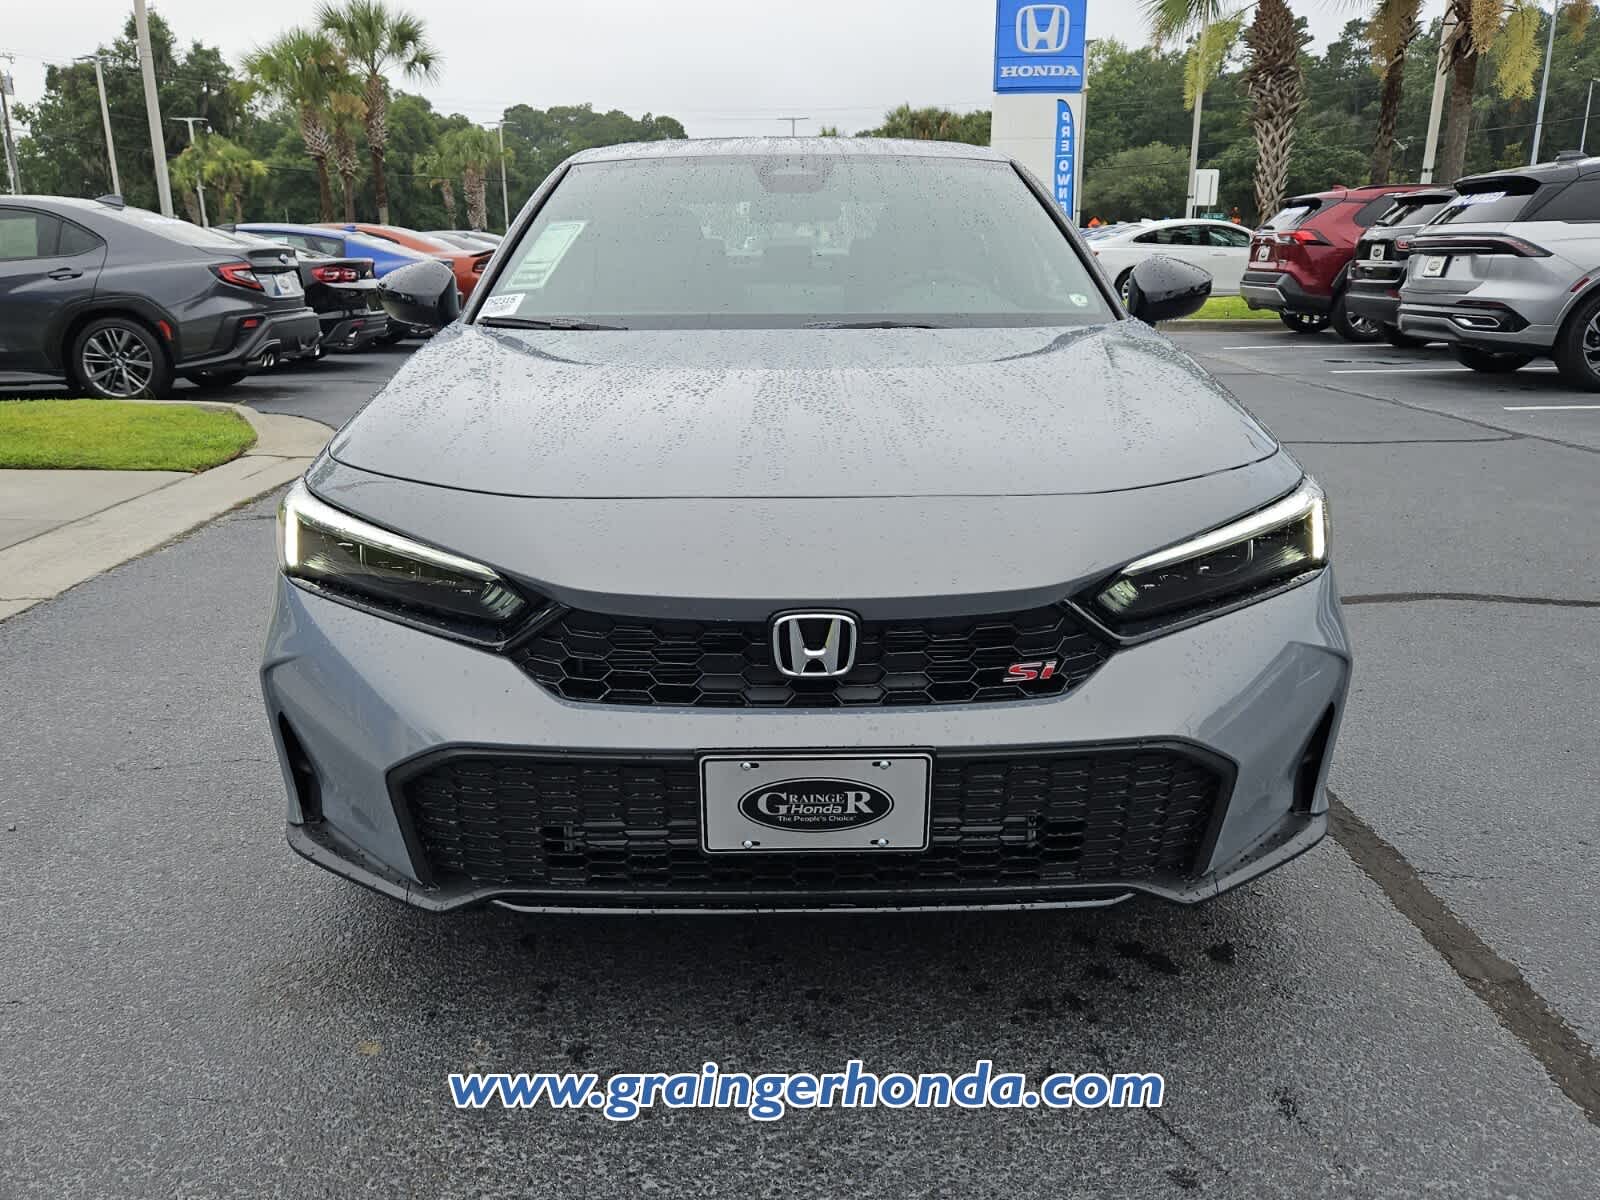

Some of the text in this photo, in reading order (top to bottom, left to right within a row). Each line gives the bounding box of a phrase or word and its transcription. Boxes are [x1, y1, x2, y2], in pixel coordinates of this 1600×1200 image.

[1000, 65, 1081, 78] HONDA
[757, 791, 874, 815] GRAINGER
[790, 804, 842, 814] Honda
